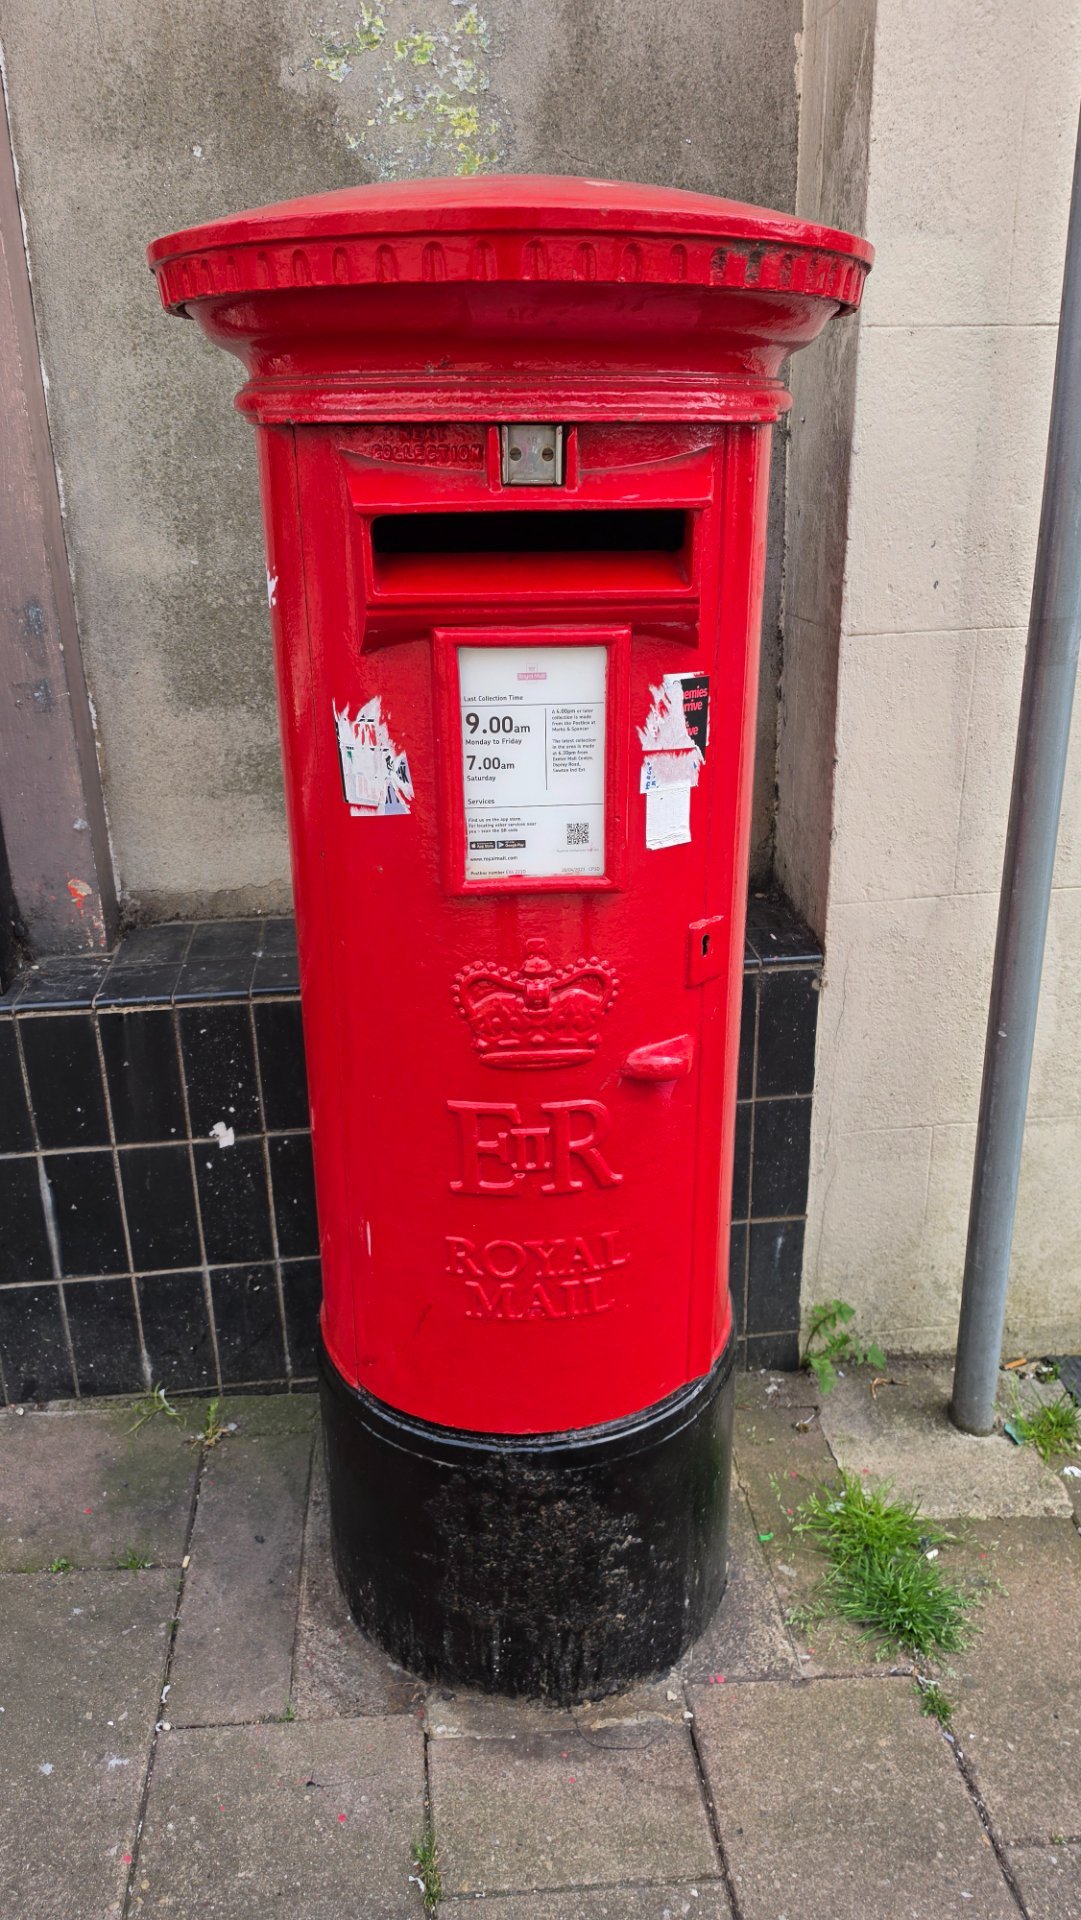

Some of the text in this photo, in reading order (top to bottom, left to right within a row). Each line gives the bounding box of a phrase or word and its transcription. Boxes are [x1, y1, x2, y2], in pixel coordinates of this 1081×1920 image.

[372, 442, 484, 462] COLLECTION
[683, 685, 708, 700] emies
[465, 712, 531, 735] 9.00am
[465, 738, 492, 746] Monday
[501, 737, 522, 746] Friday
[466, 755, 515, 771] 7.00am
[466, 775, 497, 783] Saturday
[467, 798, 495, 806] Services
[445, 1231, 632, 1278] ROYAL
[464, 1277, 616, 1322] MAIL
